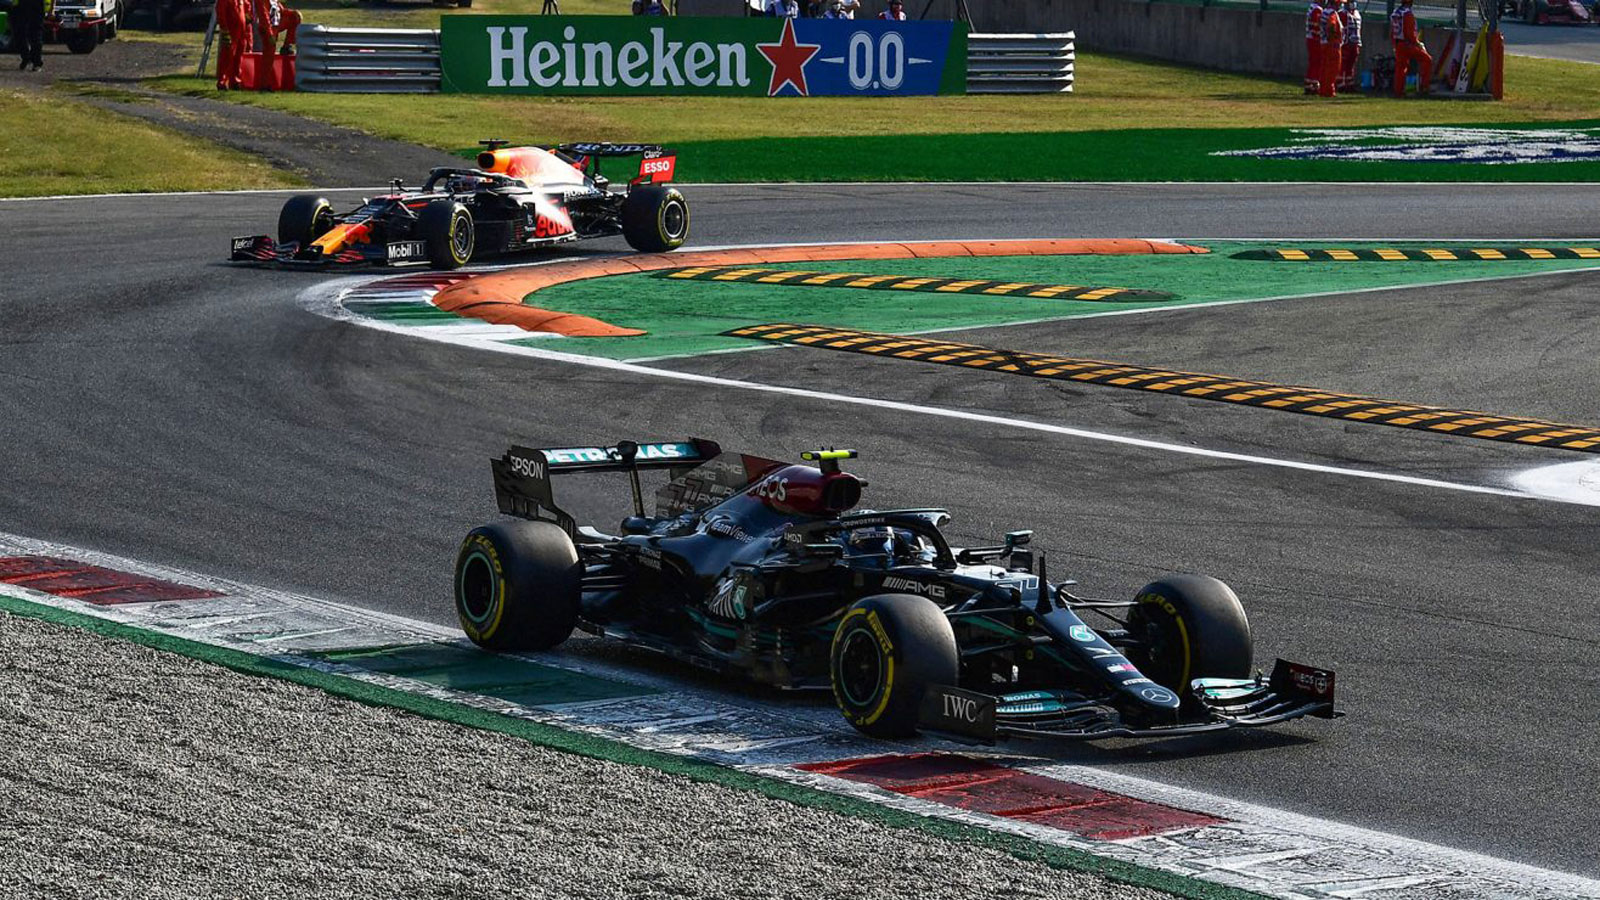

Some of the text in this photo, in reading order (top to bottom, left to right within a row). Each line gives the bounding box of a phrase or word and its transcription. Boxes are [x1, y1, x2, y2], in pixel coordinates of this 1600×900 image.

[486, 26, 904, 89] Heineken 0.0
[644, 162, 670, 173] ESSO
[388, 243, 412, 259] Mobil
[903, 579, 946, 599] AMG
[942, 693, 976, 723] IWC
